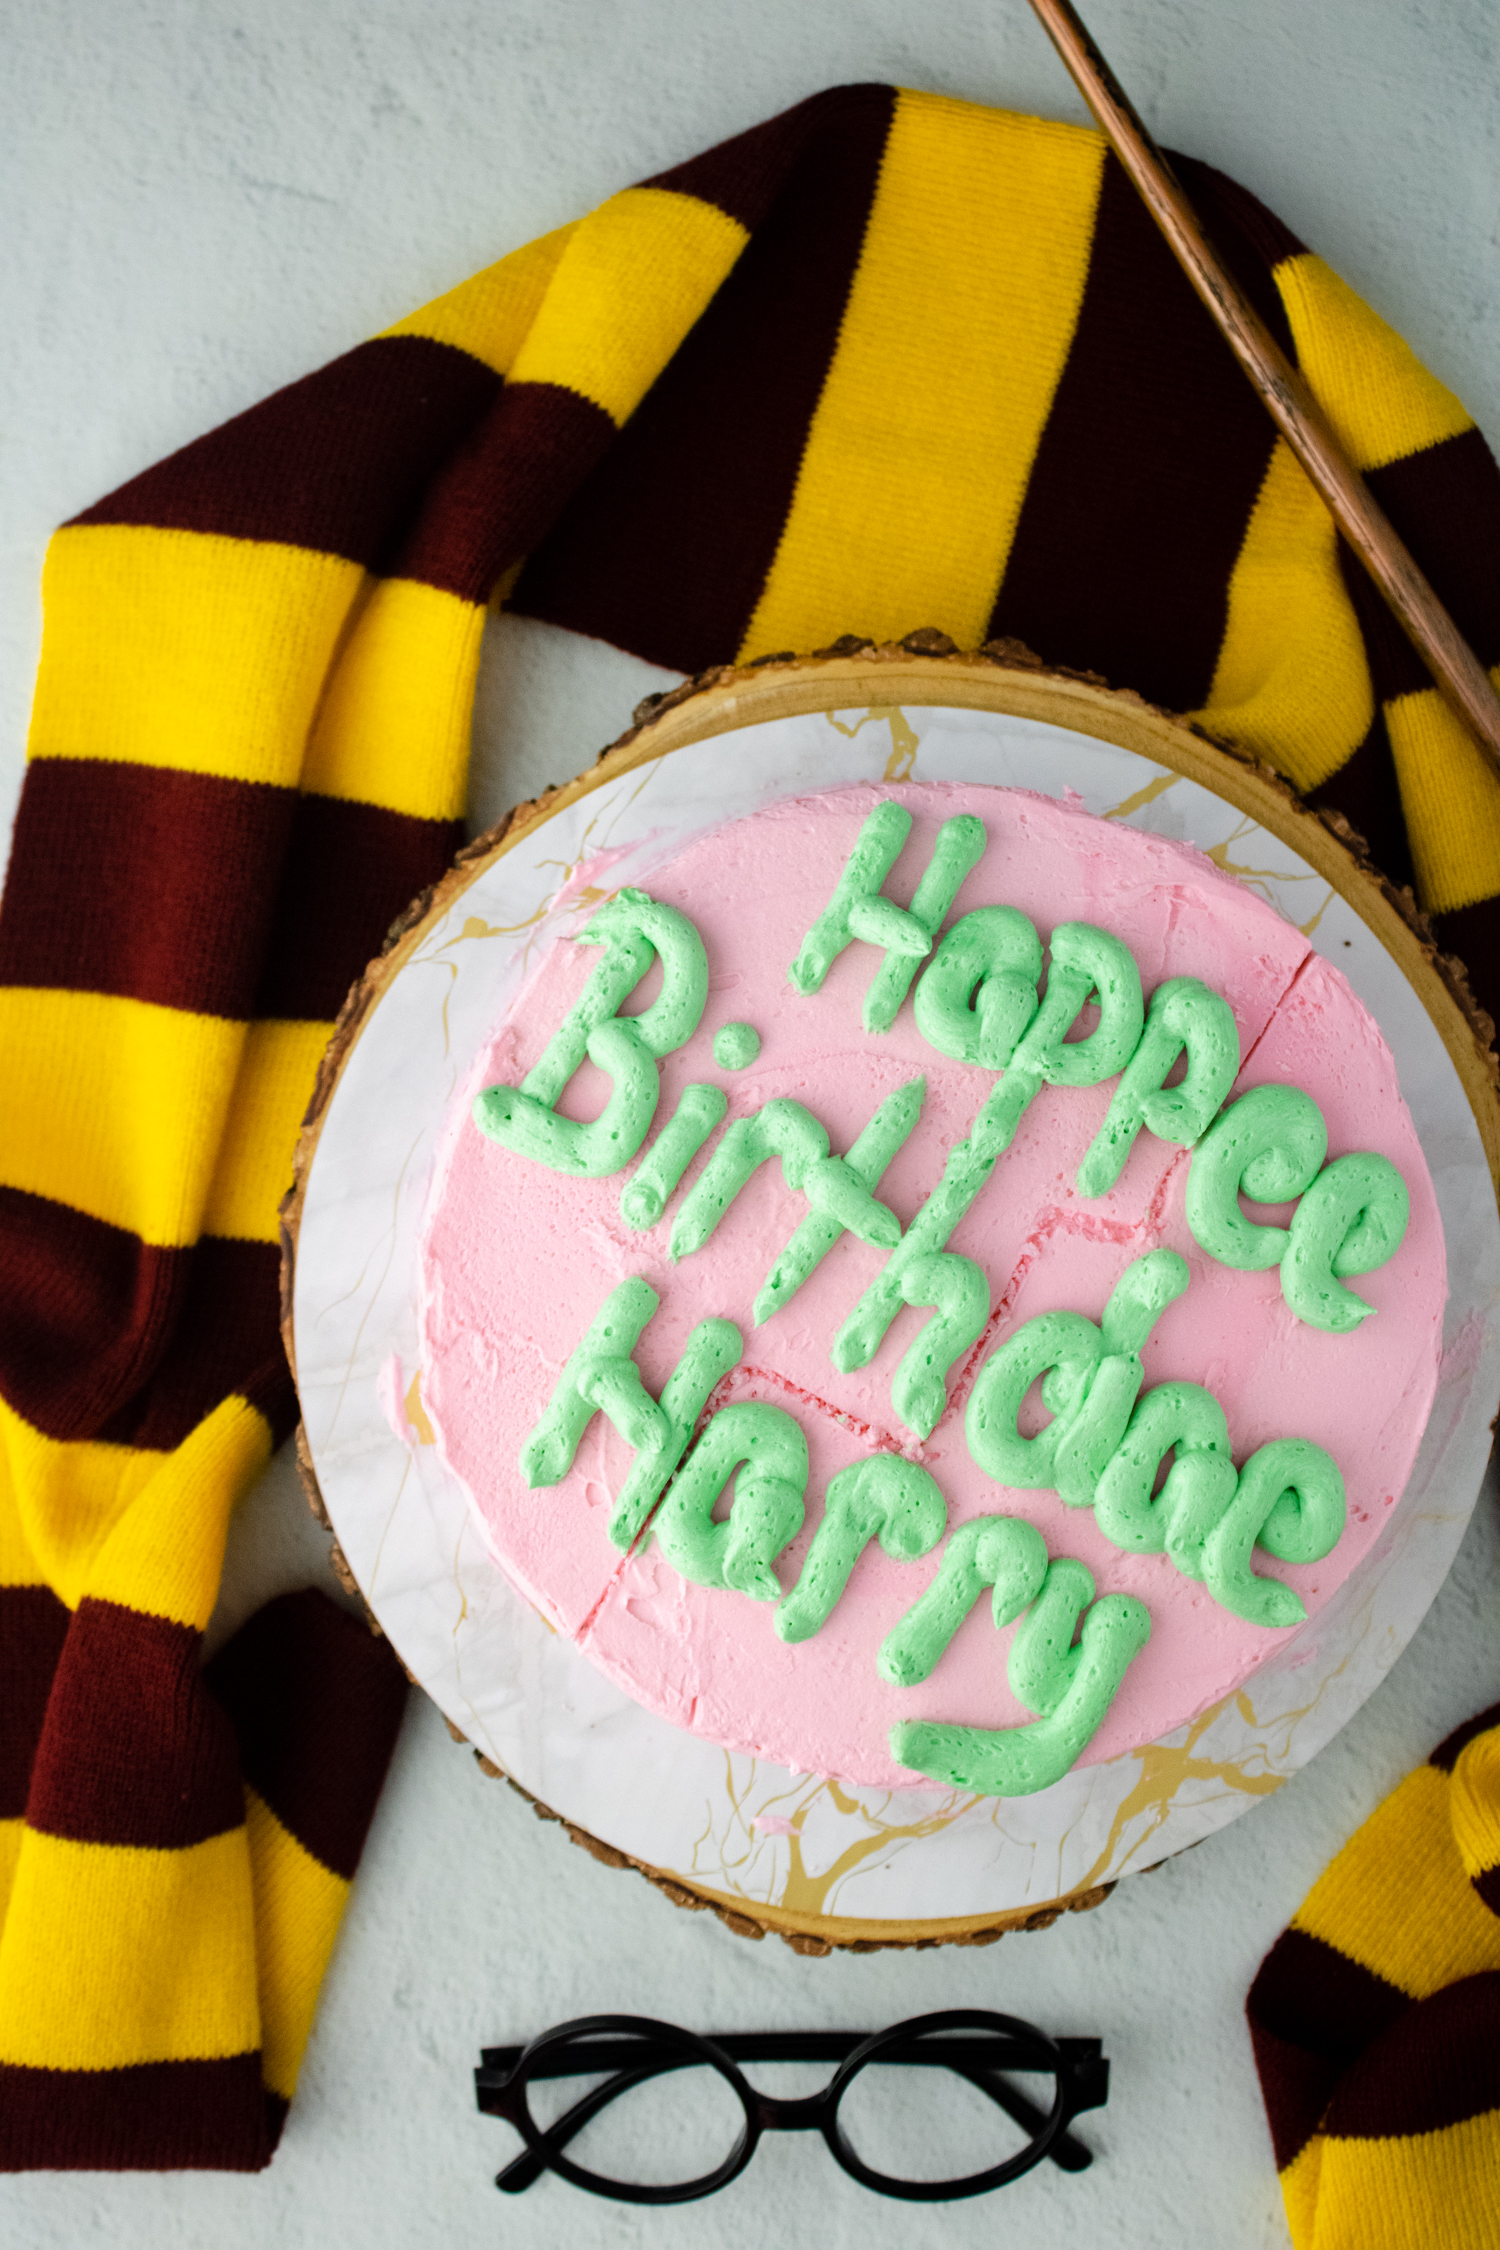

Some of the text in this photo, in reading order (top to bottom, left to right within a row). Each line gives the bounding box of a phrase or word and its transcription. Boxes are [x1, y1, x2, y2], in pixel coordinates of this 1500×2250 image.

[472, 887, 1347, 1628] Birthdae
[788, 800, 1411, 1333] Happee
[519, 1276, 1151, 1797] Harry
